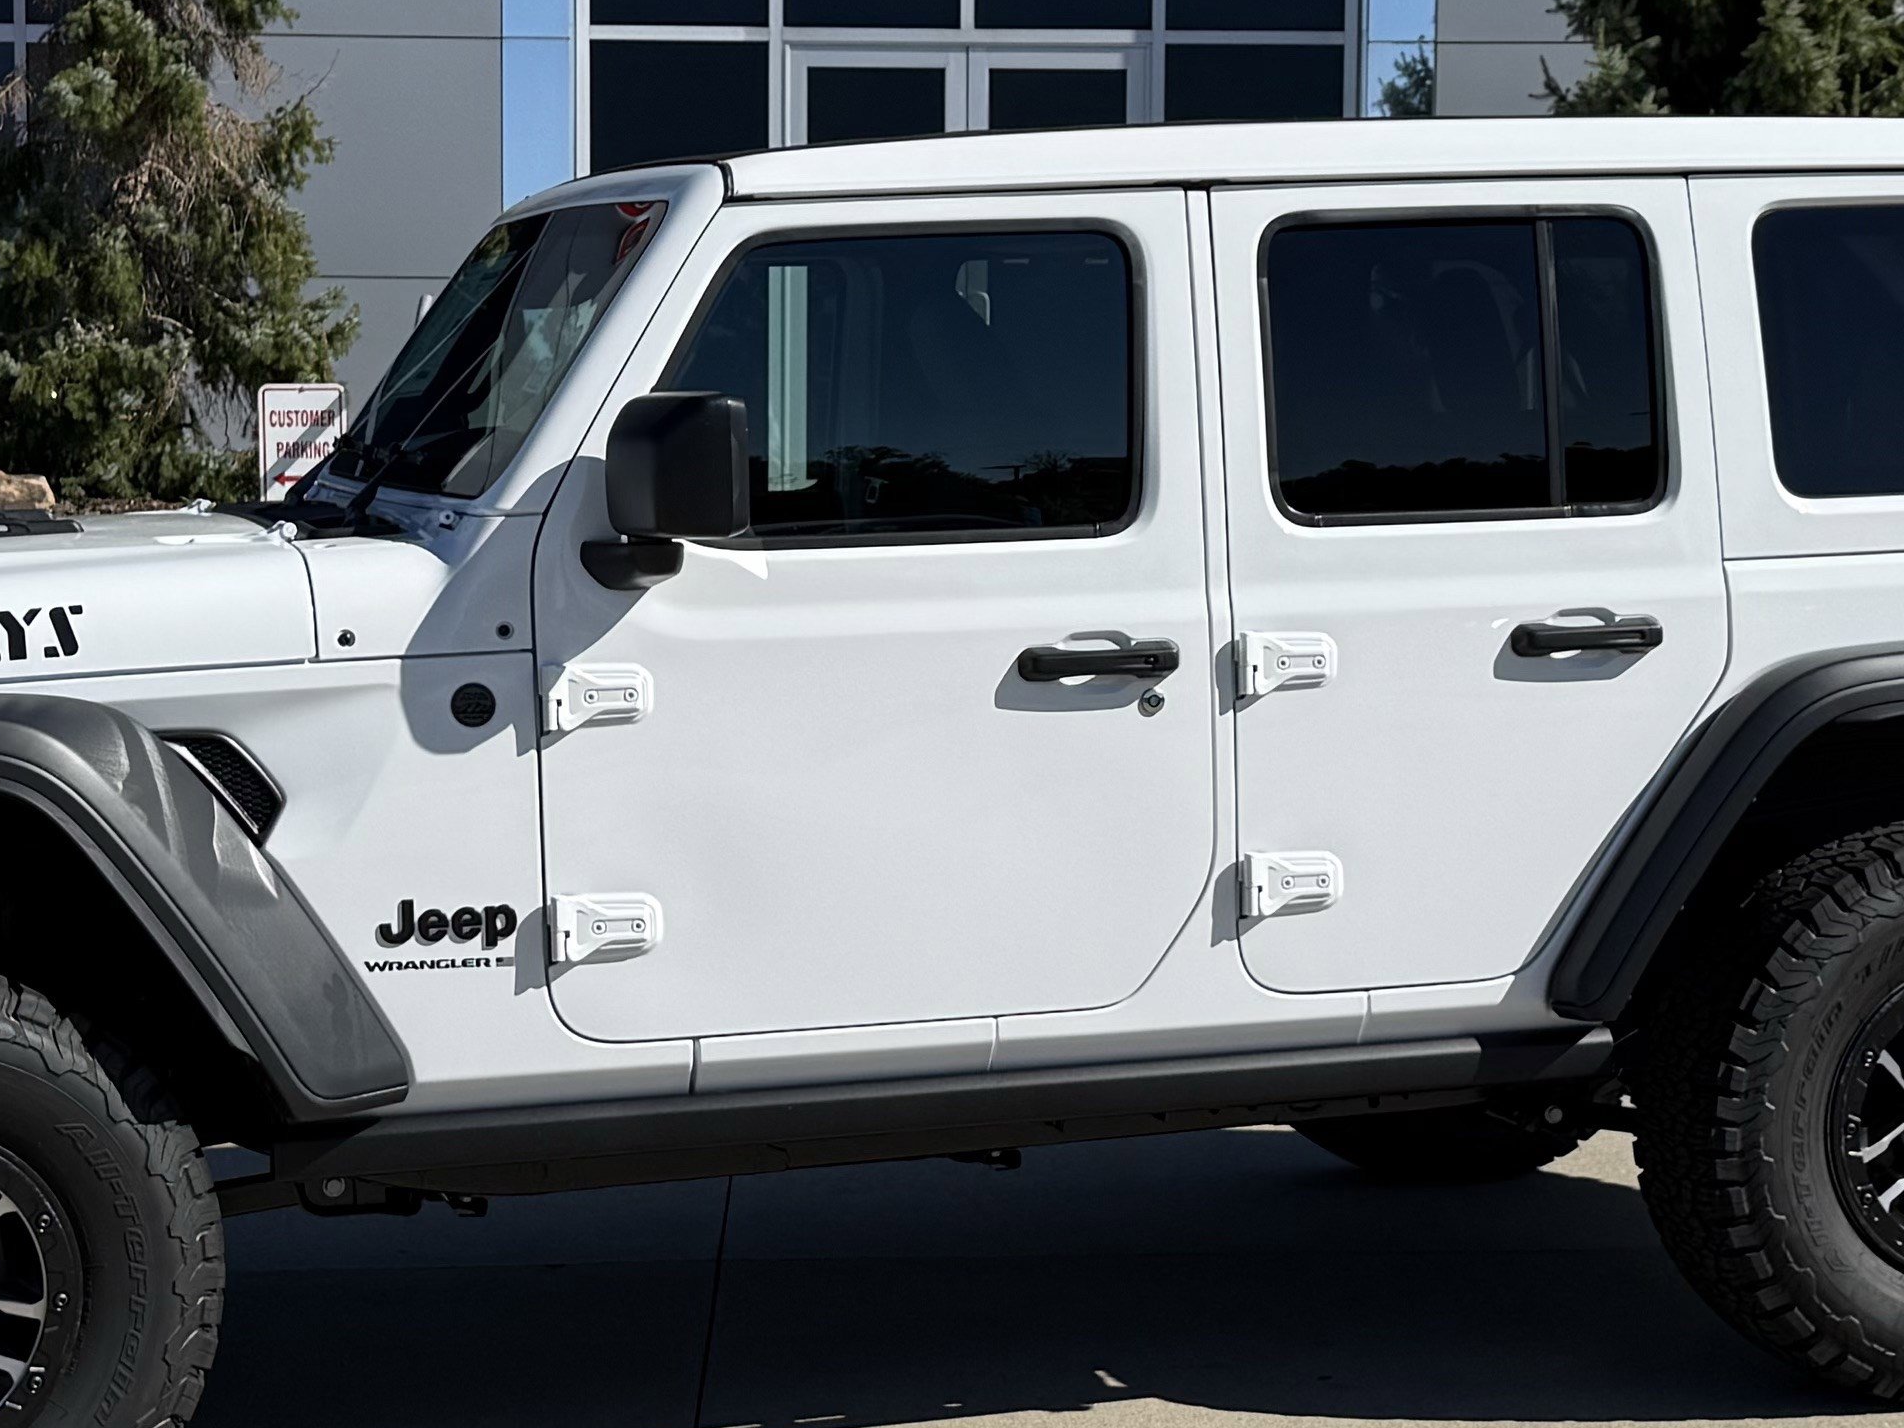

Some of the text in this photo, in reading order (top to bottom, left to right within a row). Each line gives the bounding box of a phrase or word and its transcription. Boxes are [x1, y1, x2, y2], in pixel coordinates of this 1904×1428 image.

[269, 409, 335, 428] CUSTOMER
[276, 441, 331, 459] PARKING
[377, 899, 517, 948] Jeep
[363, 957, 492, 973] WRANGLER
